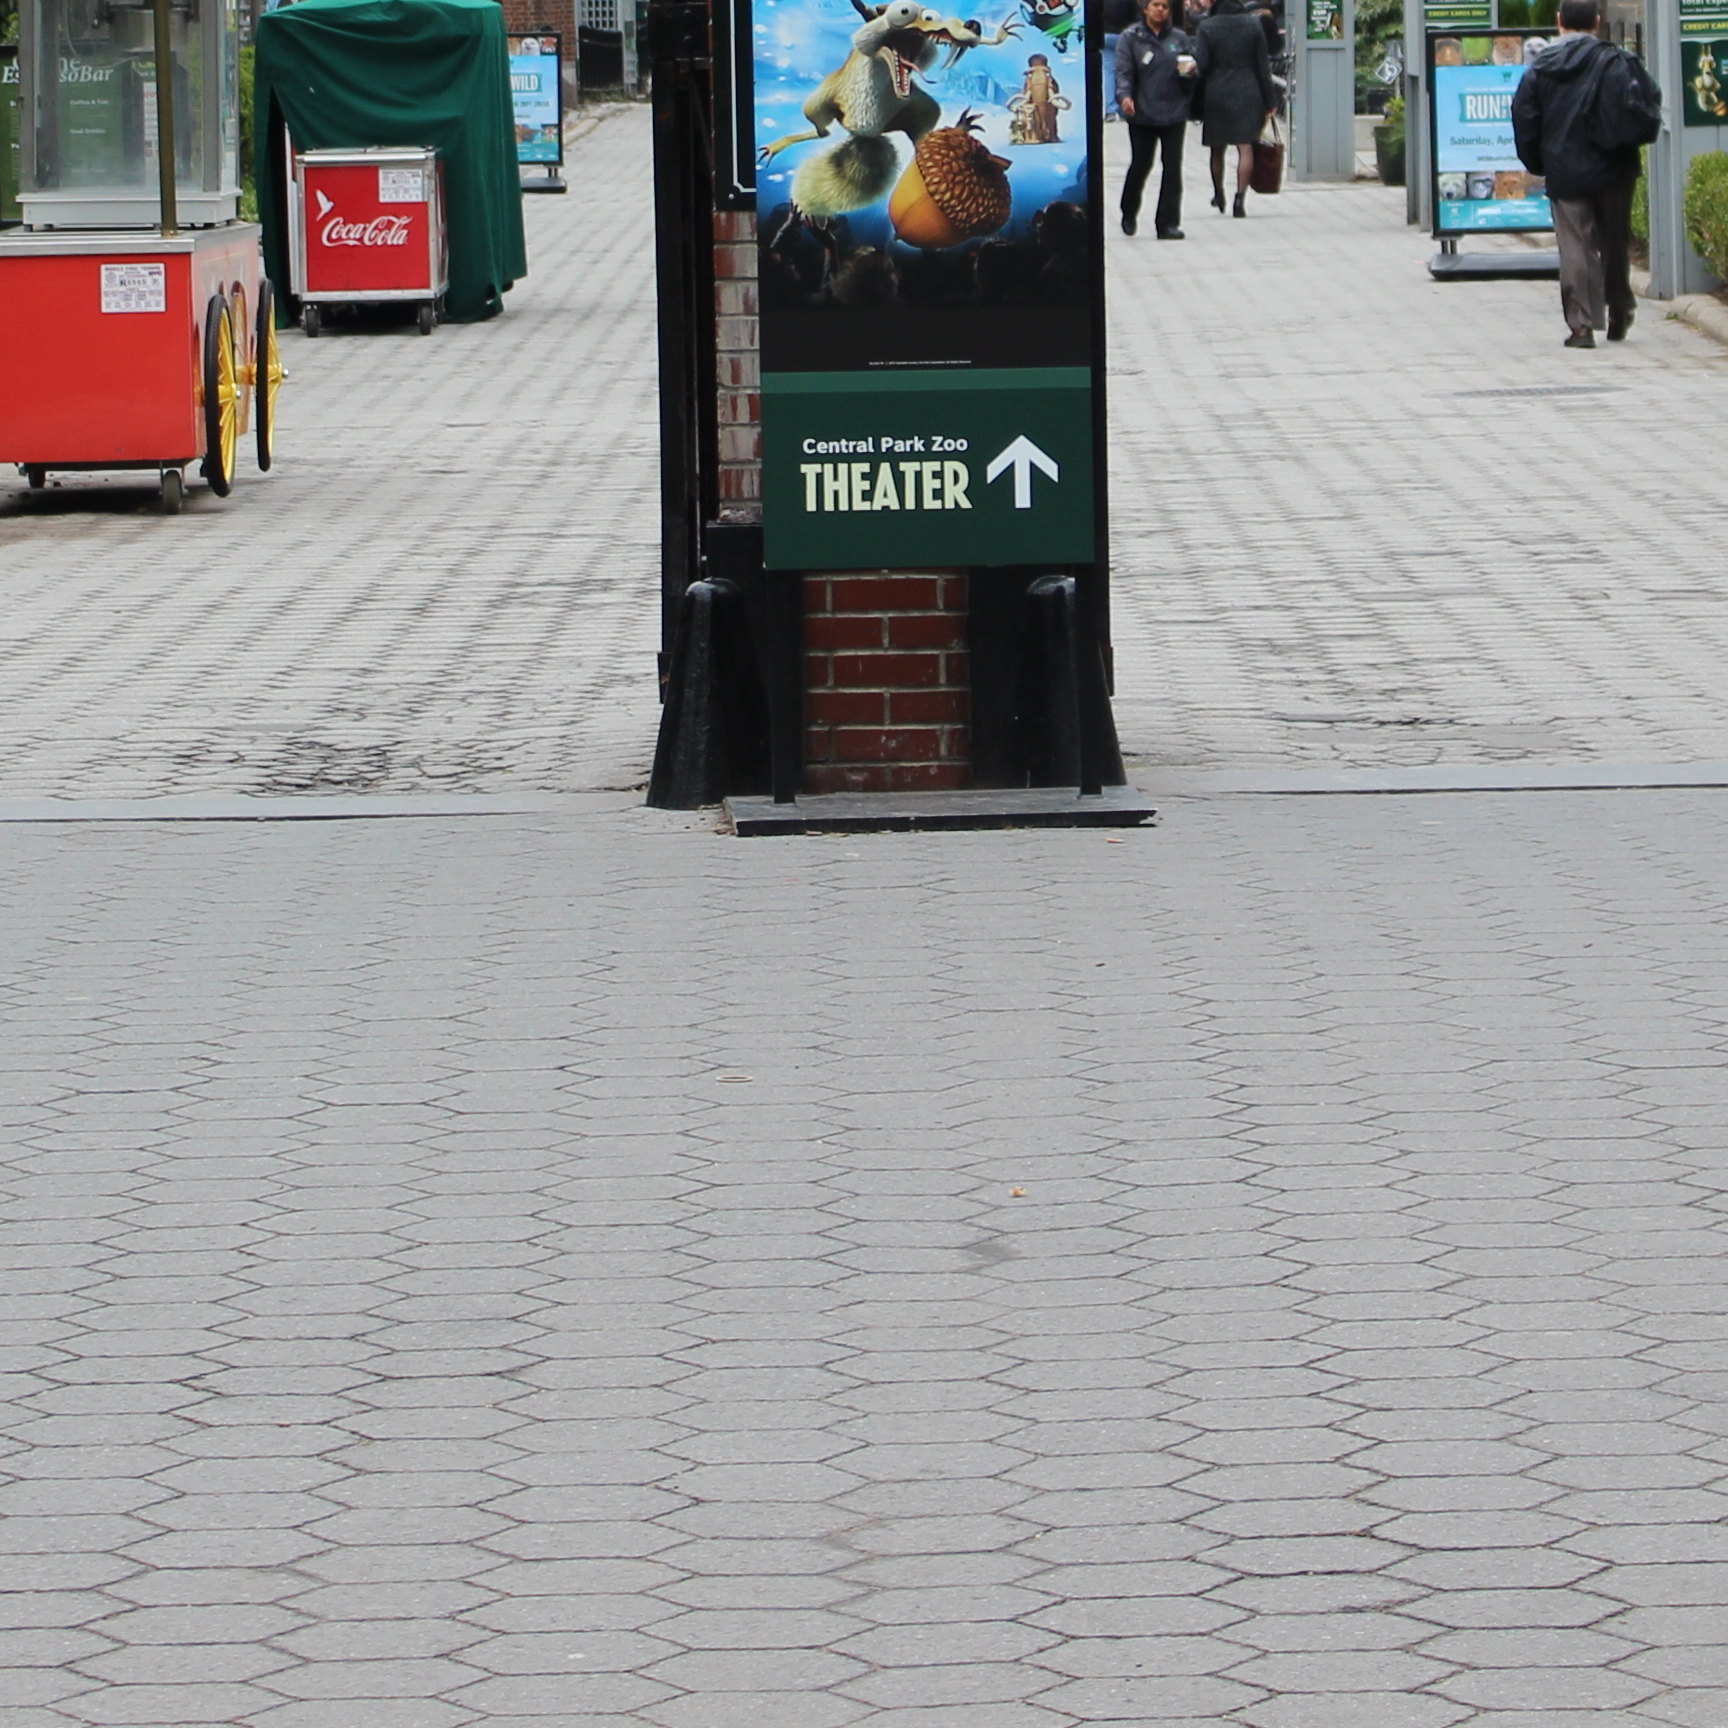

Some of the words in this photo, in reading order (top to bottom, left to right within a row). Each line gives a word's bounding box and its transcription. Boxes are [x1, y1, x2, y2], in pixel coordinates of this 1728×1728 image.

[1683, 22, 1710, 31] CREDIT
[511, 74, 539, 91] WILD
[1465, 95, 1501, 121] RUN
[1450, 136, 1495, 147] Saturday,
[1496, 135, 1514, 146] Apr
[321, 215, 414, 247] Coca-Cola
[802, 436, 875, 455] Central
[880, 435, 926, 453] Park
[931, 435, 969, 452] Zoo
[800, 459, 973, 512] THEATER
